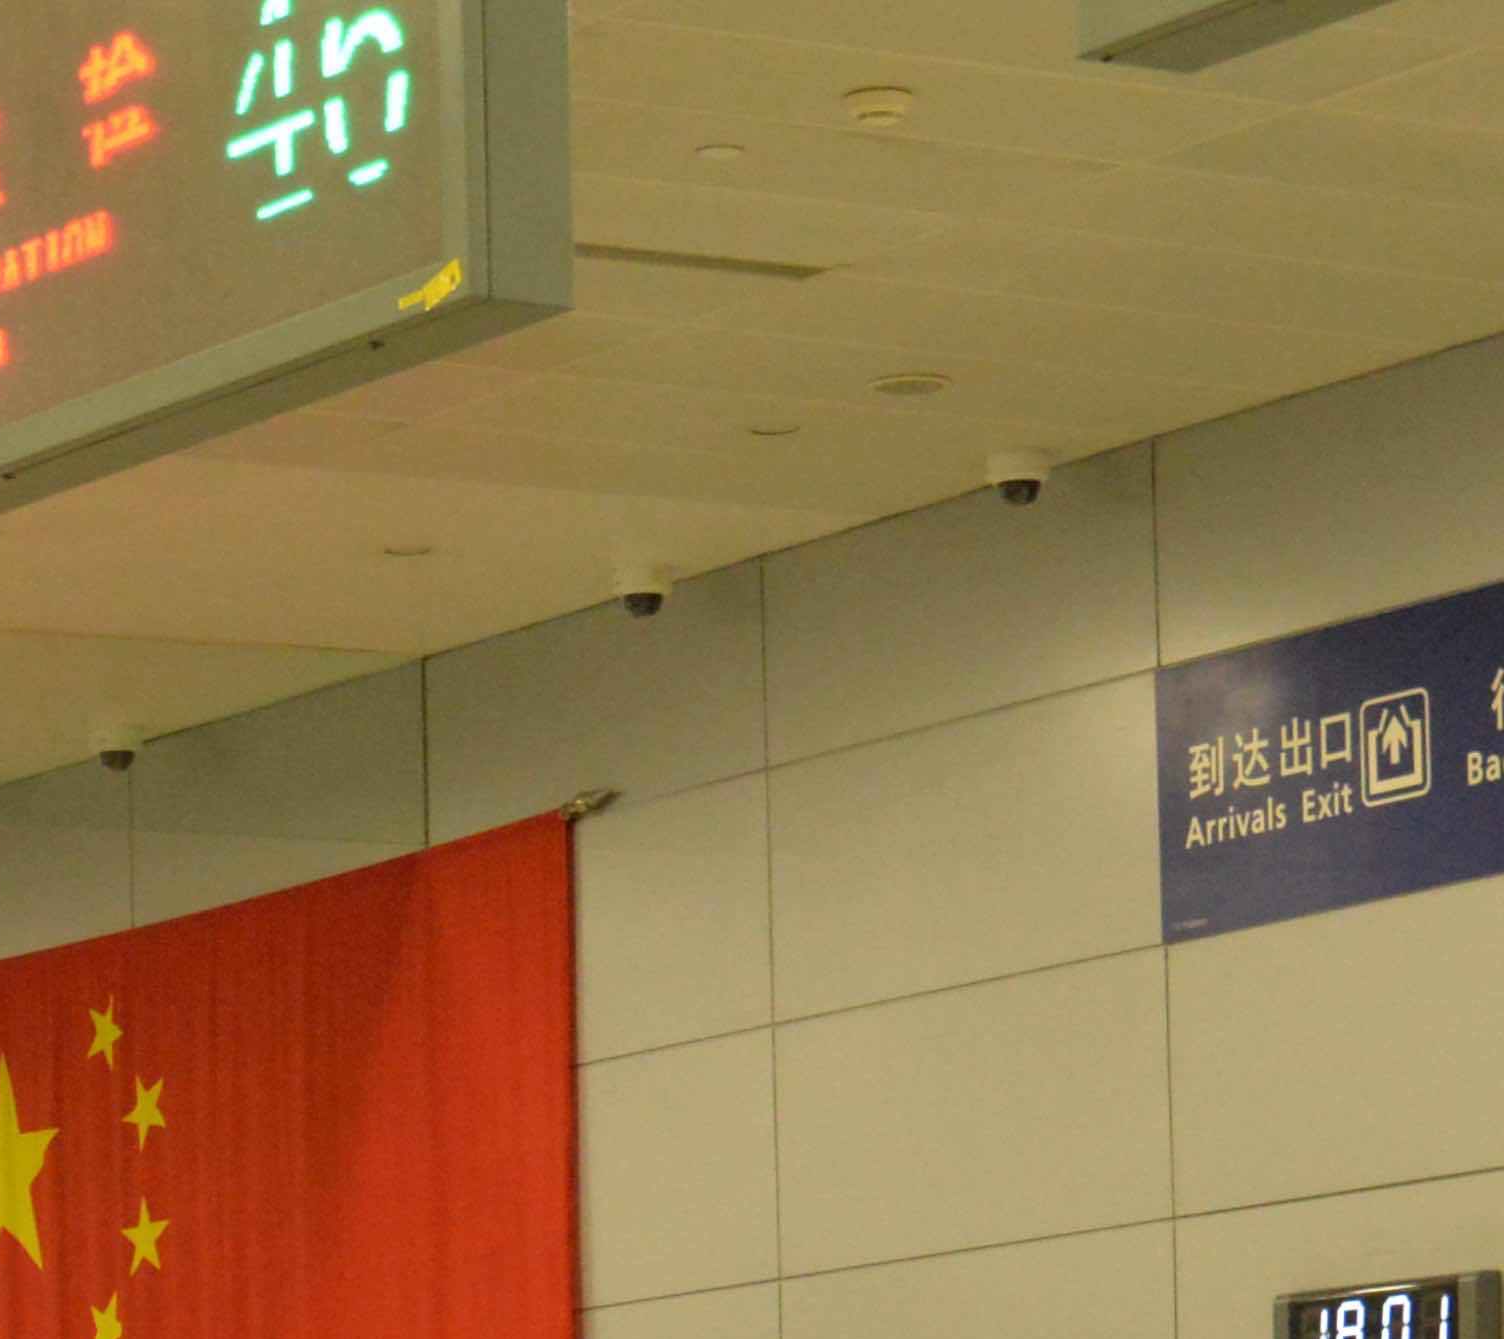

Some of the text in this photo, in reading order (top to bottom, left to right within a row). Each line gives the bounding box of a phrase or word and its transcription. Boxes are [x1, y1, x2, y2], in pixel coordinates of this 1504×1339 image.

[1189, 711, 1353, 800] 到达出口
[1185, 783, 1353, 849] Arrivals Exit
